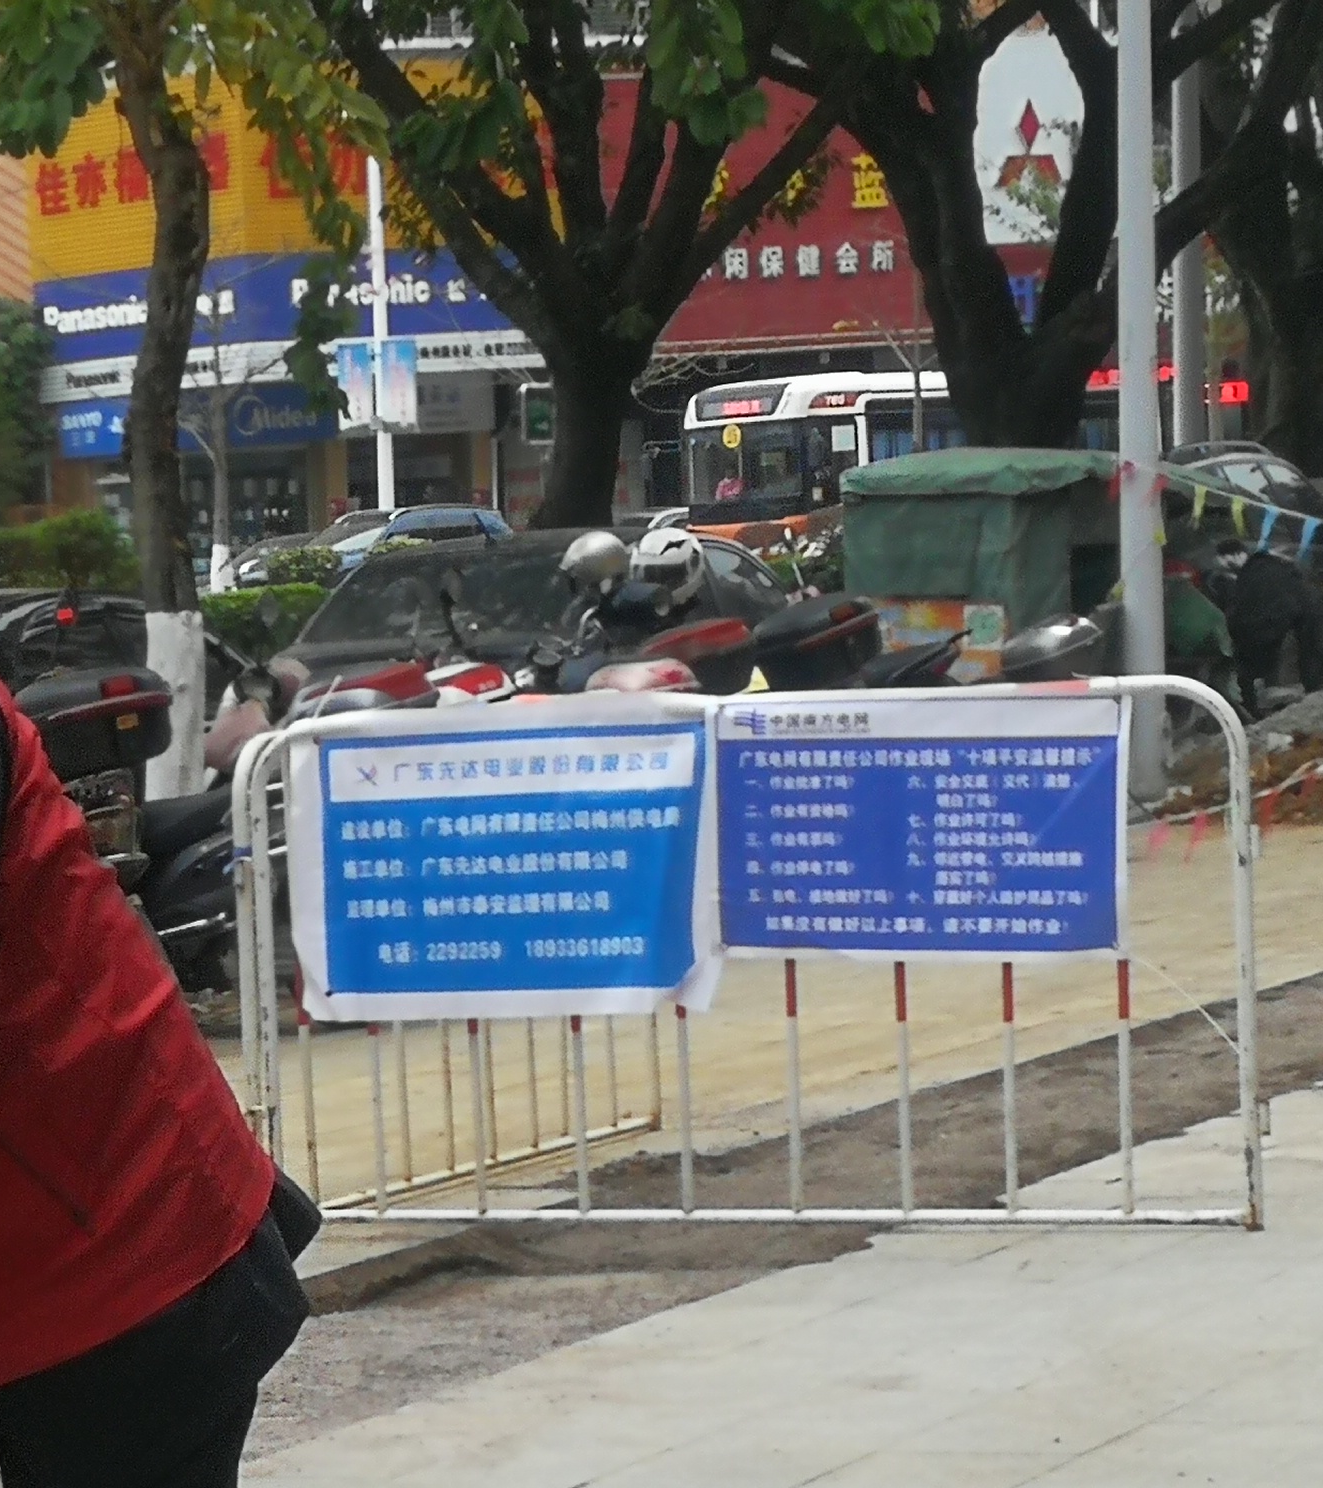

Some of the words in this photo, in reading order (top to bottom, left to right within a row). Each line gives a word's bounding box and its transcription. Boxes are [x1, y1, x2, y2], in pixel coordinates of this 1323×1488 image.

[700, 240, 895, 281] 闲保健会所
[392, 750, 671, 783] 广东先达电业股份有限公司
